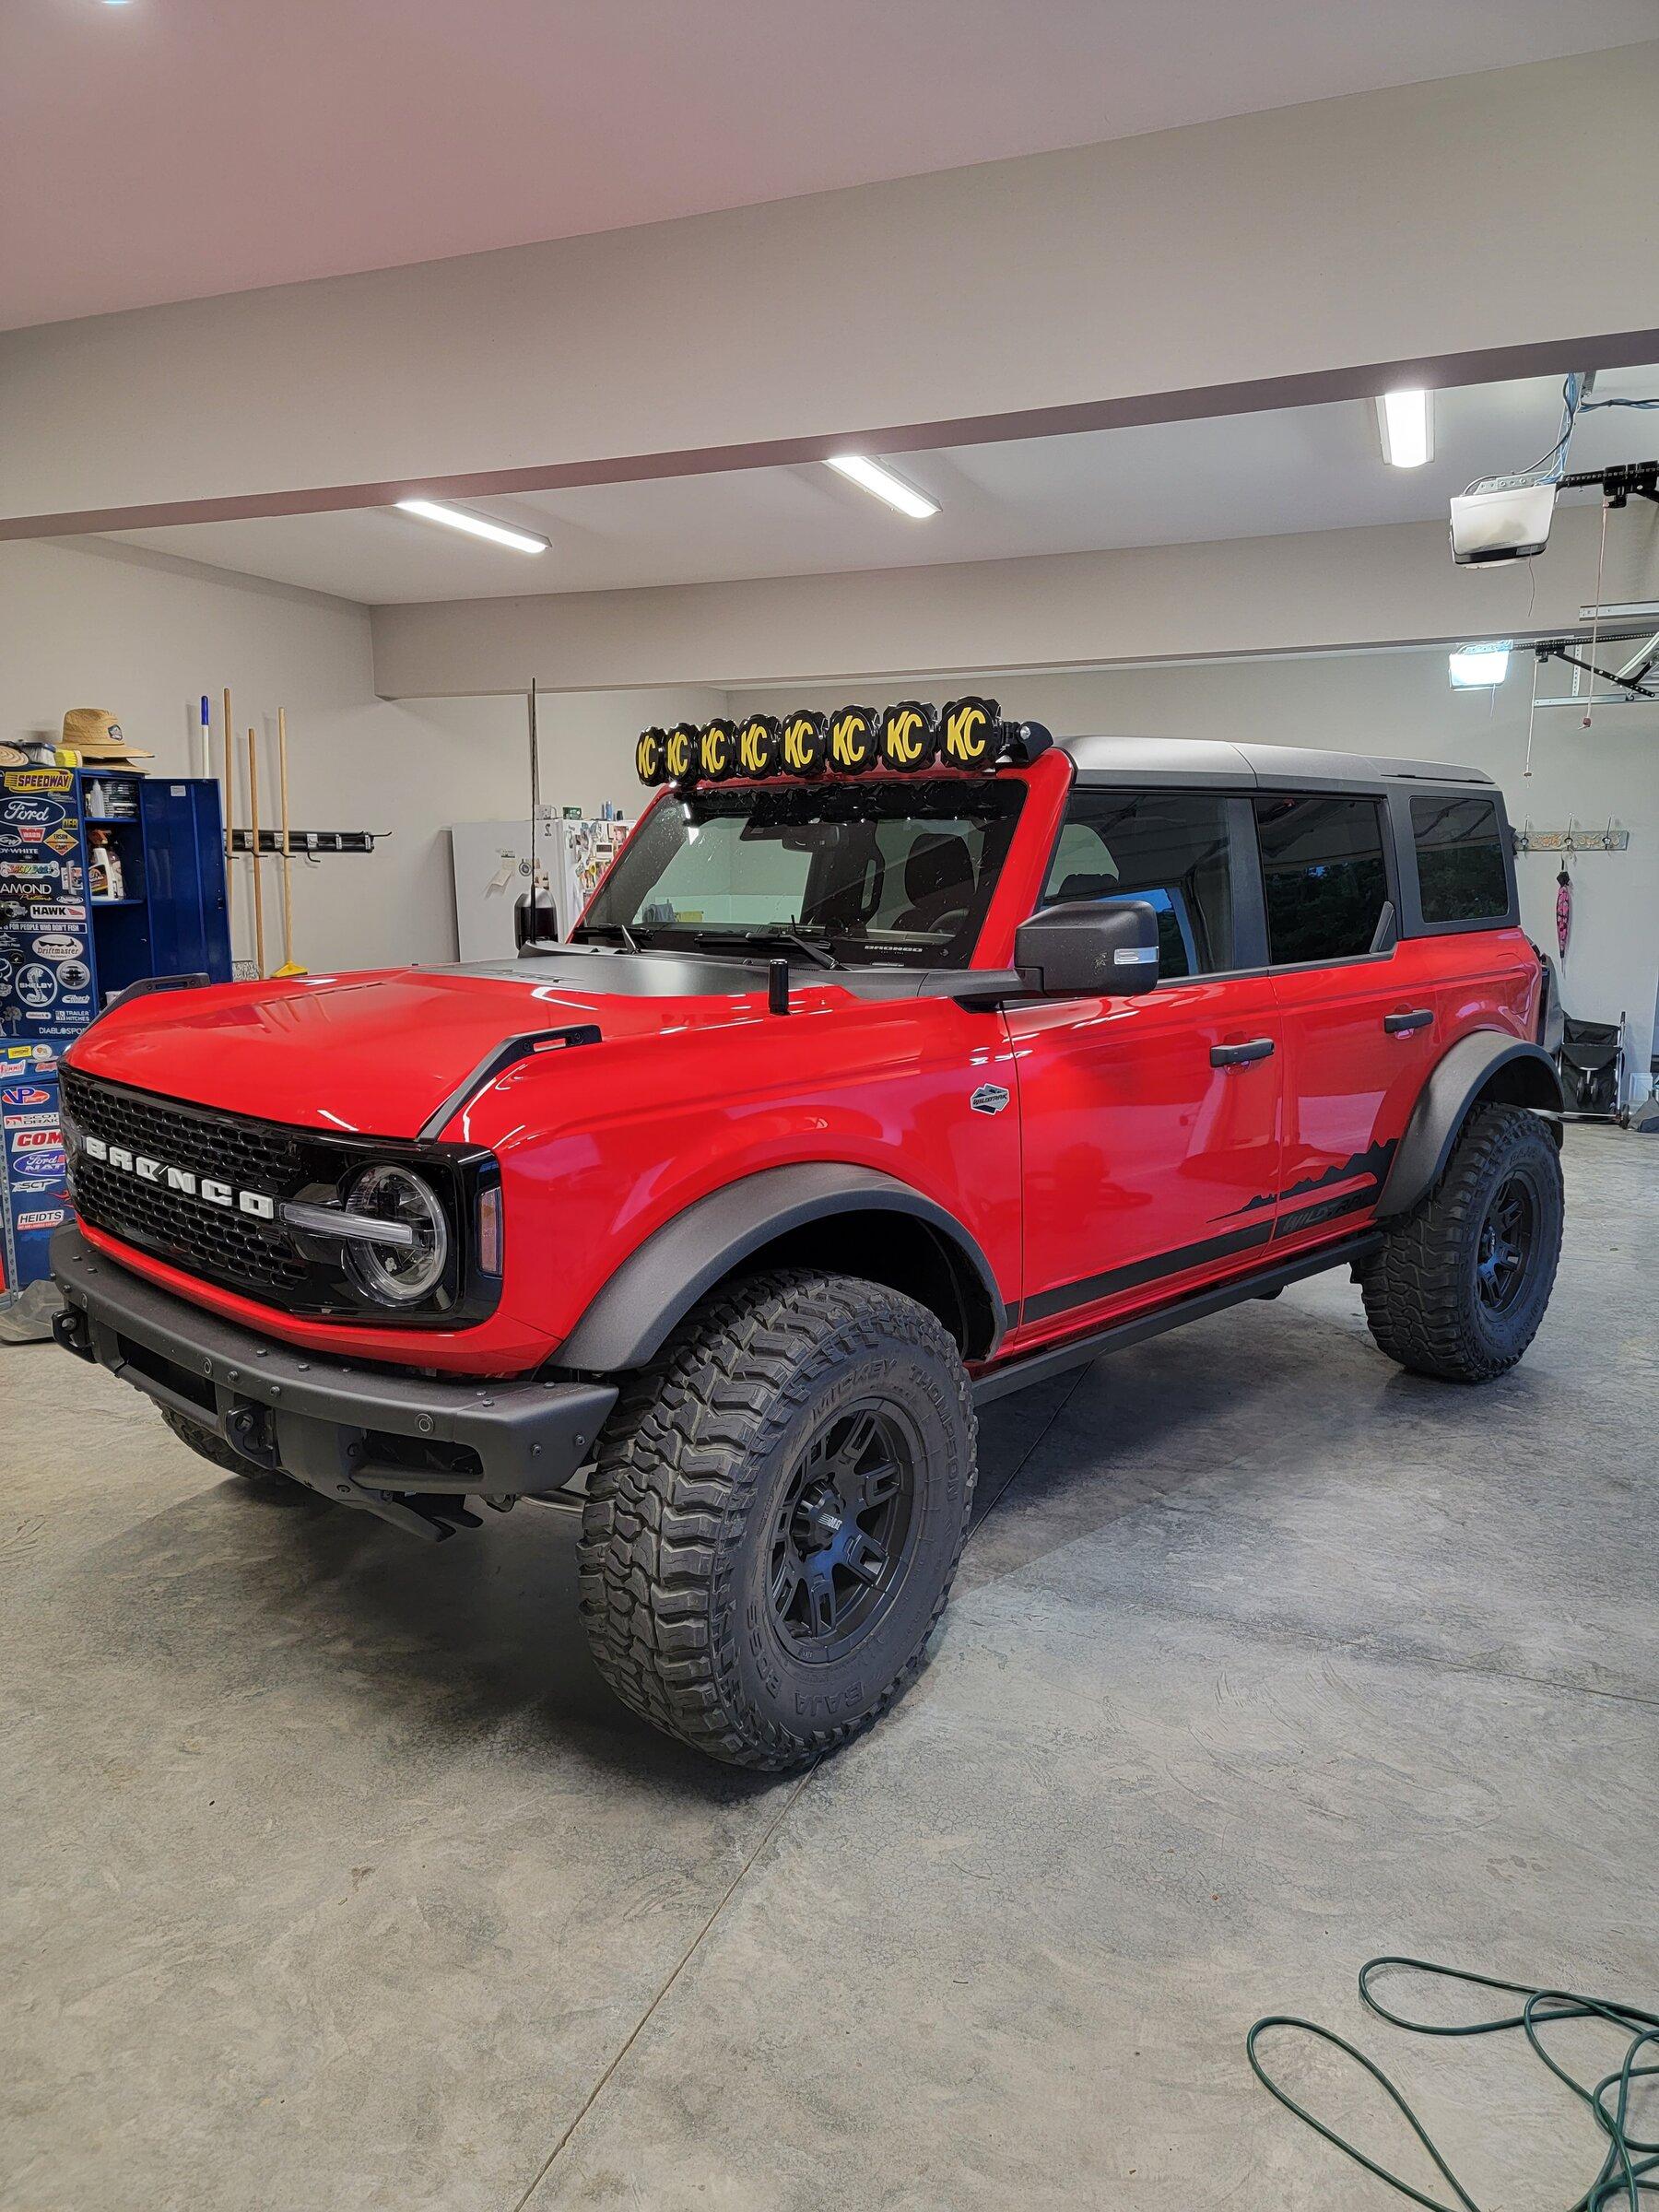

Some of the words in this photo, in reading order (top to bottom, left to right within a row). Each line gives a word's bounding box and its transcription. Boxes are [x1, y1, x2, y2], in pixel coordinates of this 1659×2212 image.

[667, 732, 688, 776] KC
[701, 727, 725, 773] KC
[741, 724, 768, 771] KC
[785, 720, 814, 768] KC
[833, 715, 865, 765] KC
[888, 711, 923, 763] KC
[947, 707, 986, 760] KC
[638, 735, 656, 779] KC
[18, 774, 69, 787] SPEEDWAY
[4, 800, 50, 821] Ford
[32, 906, 66, 916] HAWK
[37, 947, 79, 955] Driftmaster
[864, 945, 924, 953] BRONCO
[4, 1088, 36, 1104] VP
[24, 1163, 65, 1172] NAT
[26, 1154, 58, 1166] Ford
[86, 1135, 275, 1219] BRONCO
[19, 1211, 63, 1224] HEIDTS
[908, 1362, 959, 1502] THOMPSON
